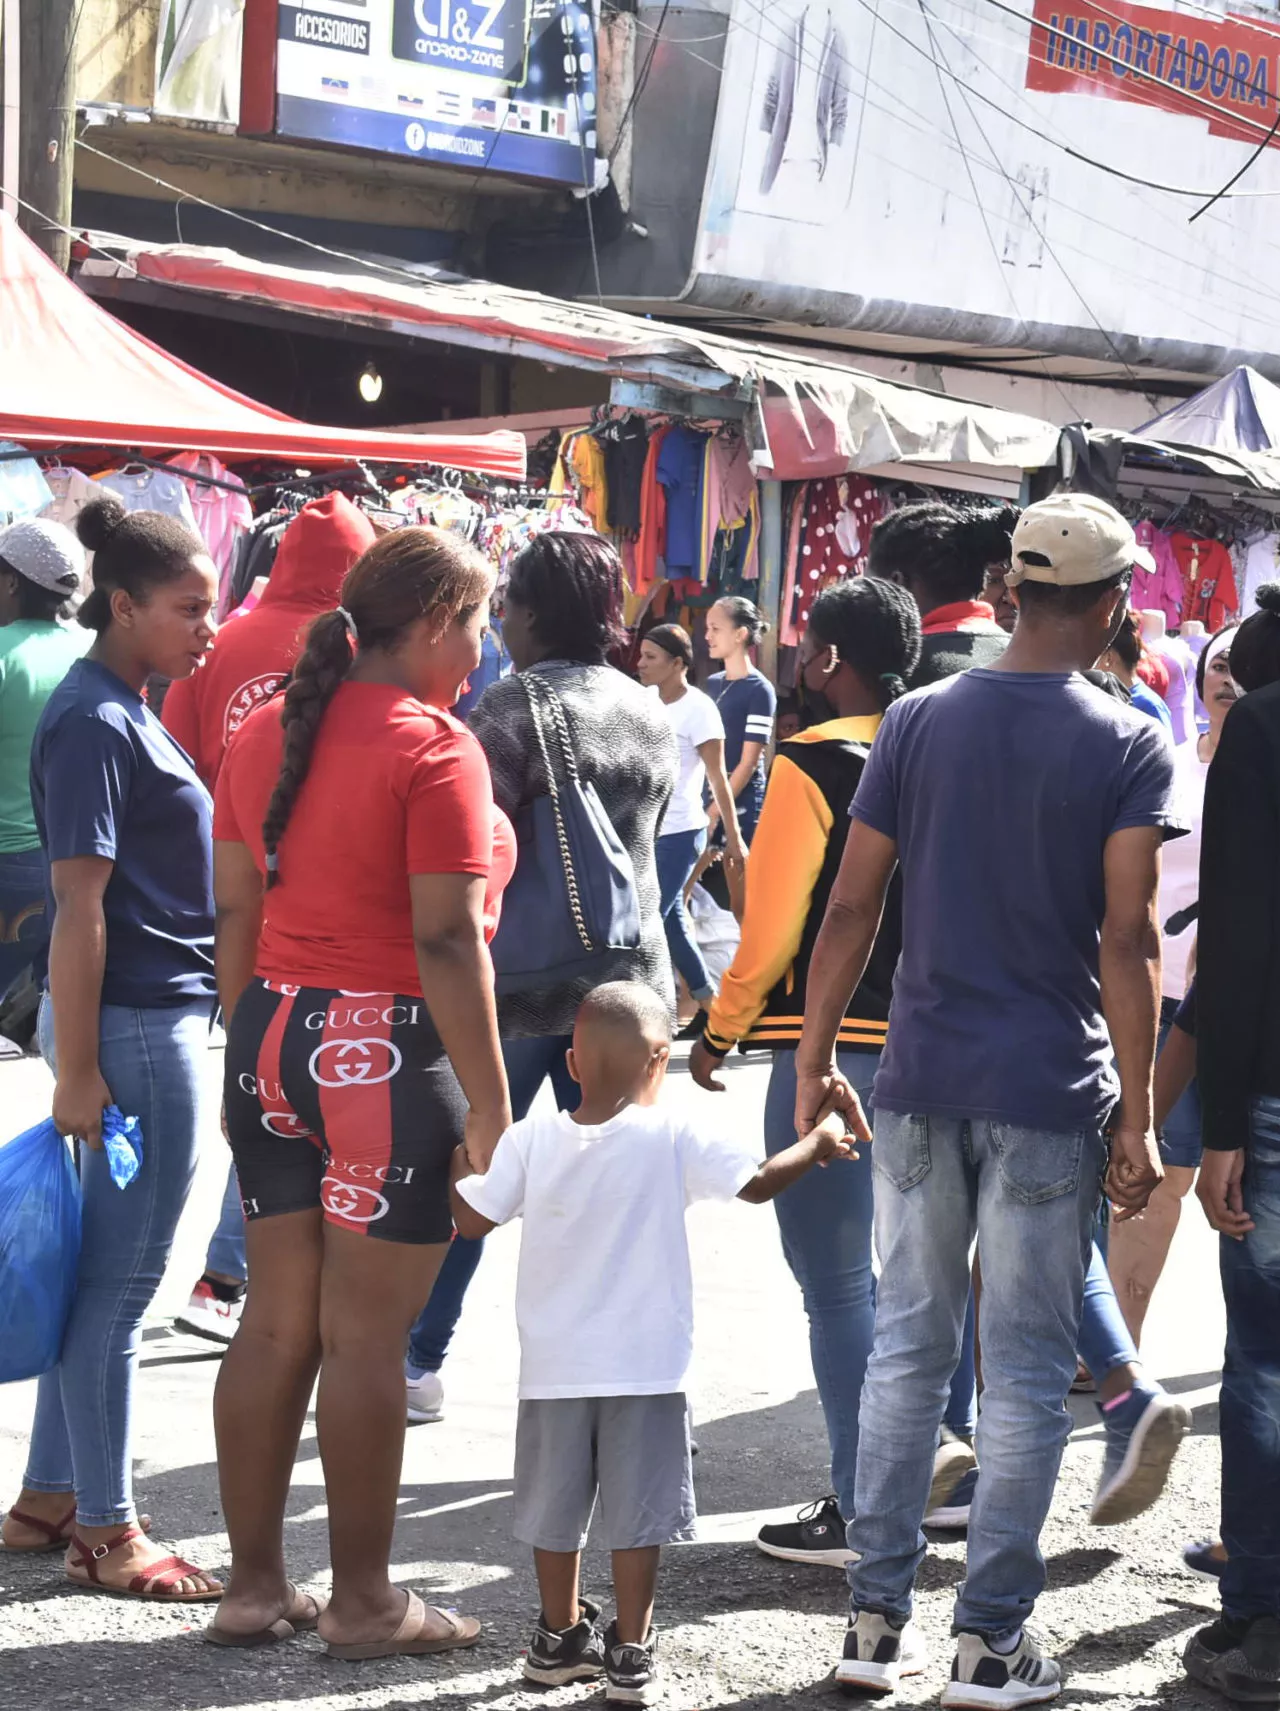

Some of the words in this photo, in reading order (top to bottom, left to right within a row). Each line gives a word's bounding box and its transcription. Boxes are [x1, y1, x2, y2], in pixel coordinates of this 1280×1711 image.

[294, 12, 367, 50] ACCESORIOS
[1045, 14, 1268, 108] IMPORTADORA
[305, 1005, 421, 1030] GUCCI
